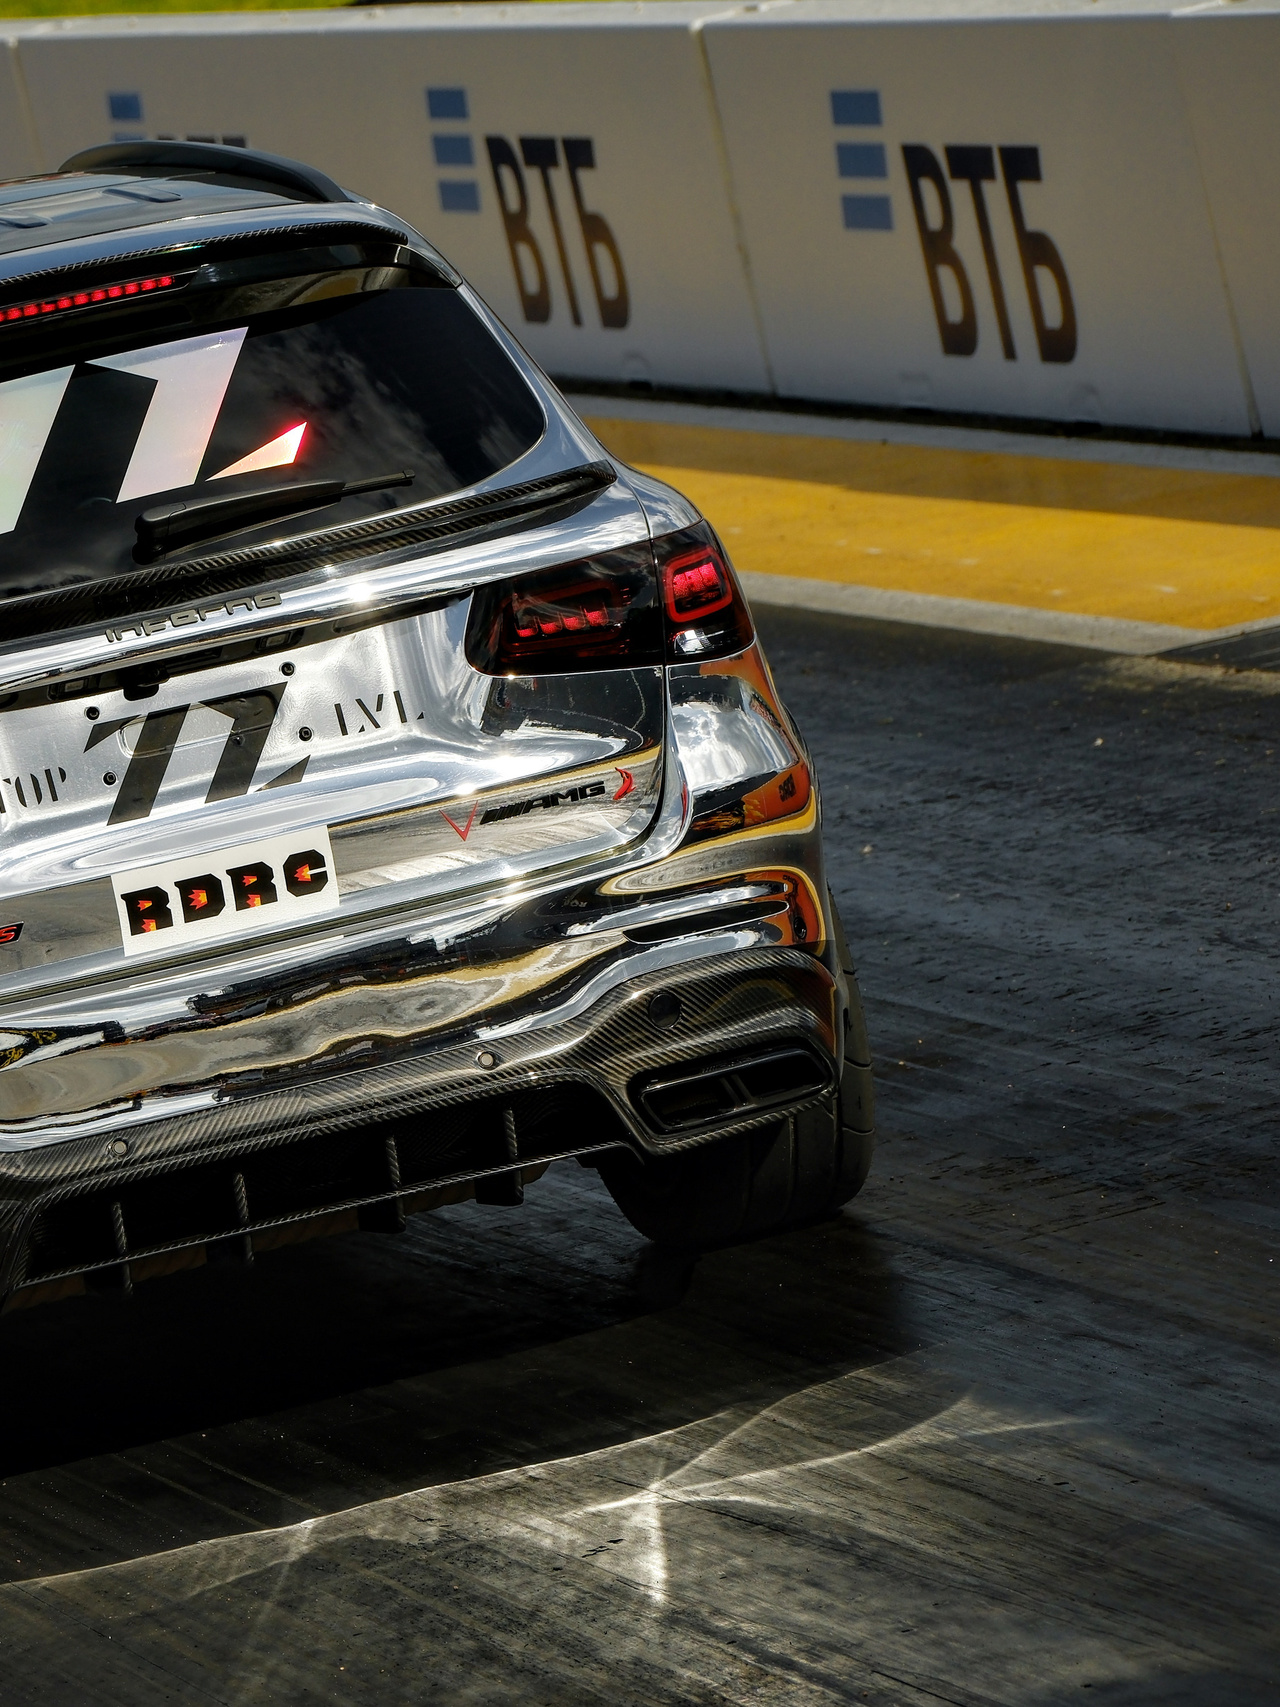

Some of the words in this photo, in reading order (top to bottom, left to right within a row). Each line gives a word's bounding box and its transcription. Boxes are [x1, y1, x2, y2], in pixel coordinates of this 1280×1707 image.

[485, 135, 629, 330] ВТБ
[900, 142, 1078, 364] ВТБ
[521, 780, 605, 815] AMG
[120, 848, 329, 937] RDRC
